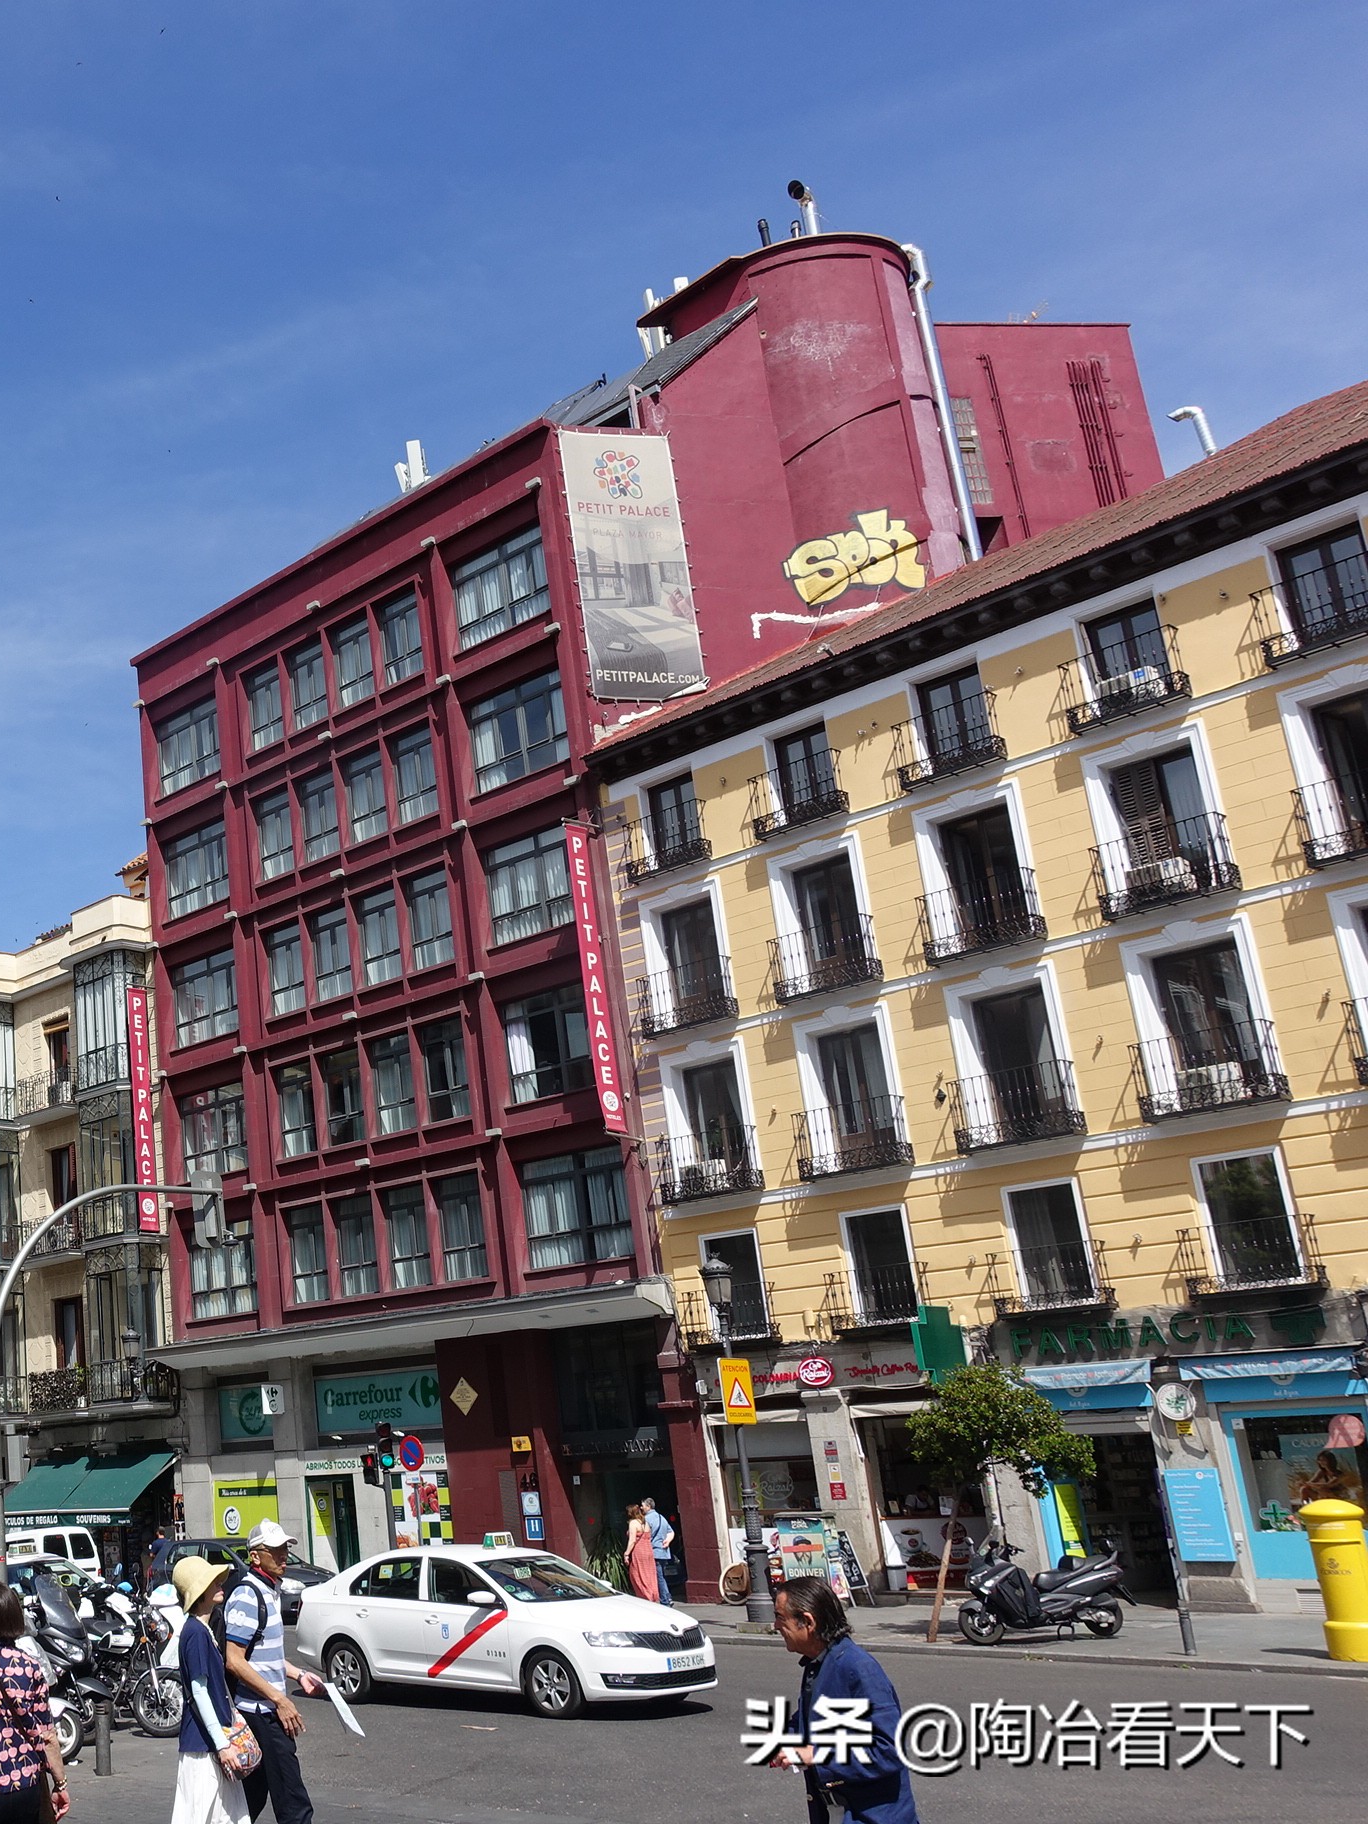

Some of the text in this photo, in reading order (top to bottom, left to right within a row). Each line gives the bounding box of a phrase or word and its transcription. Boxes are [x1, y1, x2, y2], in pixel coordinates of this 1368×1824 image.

[577, 501, 671, 517] PETIT PALACE
[593, 528, 663, 540] PLAZA MAYOR
[595, 668, 700, 684] PETITPALACE.COM
[572, 836, 614, 1085] PETIT PALACE
[133, 997, 145, 1081] PETIT
[1009, 1310, 1256, 1358] FARMACIA
[753, 1372, 799, 1384] COLOMBIA
[323, 1383, 403, 1408] Carrefour
[358, 1406, 402, 1423] express
[305, 1461, 333, 1470] ABRIMOS
[333, 1460, 356, 1470] TODOS
[26, 1516, 34, 1524] DE
[35, 1515, 58, 1525] REGALO
[76, 1514, 112, 1524] SOUVENIRS
[788, 1568, 825, 1578] BON IVER
[672, 1656, 691, 1669] 8652
